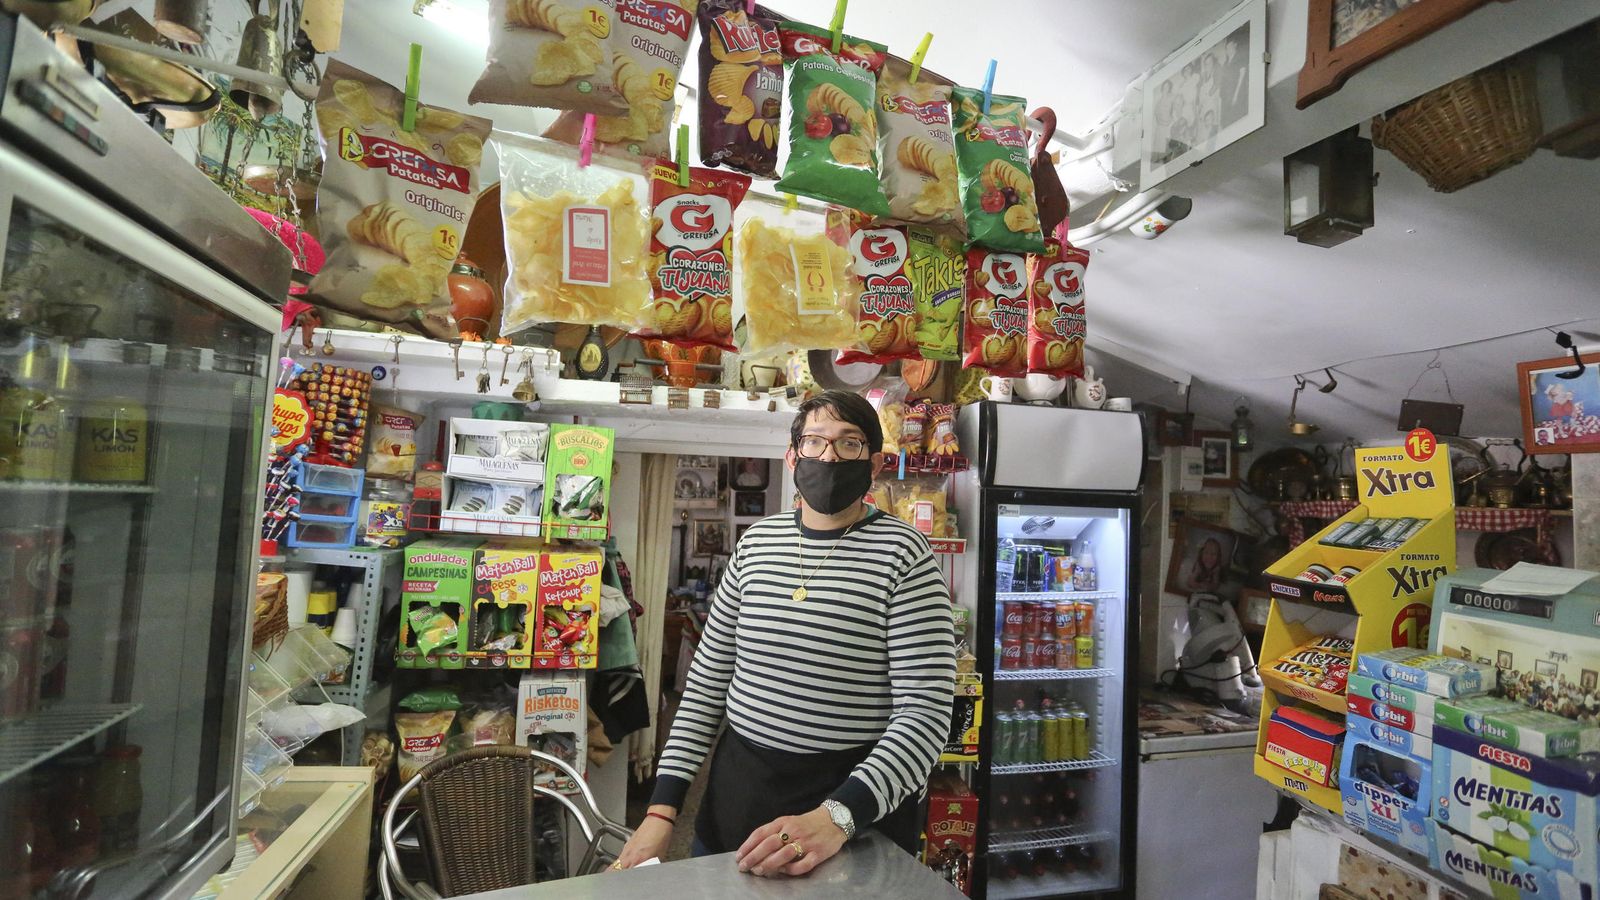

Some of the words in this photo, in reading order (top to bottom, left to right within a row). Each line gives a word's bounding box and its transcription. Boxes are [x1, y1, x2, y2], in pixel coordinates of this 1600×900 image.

[588, 8, 607, 26] 1€
[623, 11, 666, 32] Patatas
[802, 62, 834, 73] Patatas
[658, 72, 675, 89] 1€
[755, 72, 783, 93] Jamó
[391, 164, 441, 187] Patatas
[405, 190, 467, 225] Originales
[670, 205, 715, 233] G
[438, 229, 457, 248] 1€
[682, 229, 720, 240] GREFUSA
[860, 236, 897, 262] G
[672, 257, 724, 272] CORAZONES
[874, 255, 901, 268] GREFUSA
[660, 268, 732, 293] TIJUANA
[870, 284, 909, 293] CORAZONES
[914, 254, 964, 303] Takis
[1053, 270, 1080, 294] G
[92, 427, 139, 443] KAS
[1408, 436, 1431, 457] 1€
[1363, 454, 1403, 462] FORMATO
[1361, 467, 1436, 497] Xtra
[409, 552, 468, 567] onduladas
[1400, 553, 1440, 561] FORMATO
[407, 567, 468, 580] CAMPESINAS
[1387, 565, 1448, 598] Xtra
[1271, 583, 1300, 596] SNICKERS
[1313, 591, 1345, 603] Mars
[1381, 664, 1419, 684] Orbit
[1371, 683, 1408, 703] Orbit
[525, 696, 580, 714] Risketos
[1371, 701, 1408, 724] Orbit
[535, 713, 563, 721] Original
[1464, 712, 1508, 740] Orbit
[1369, 721, 1405, 745] Orbit
[1268, 744, 1286, 755] FIESTA
[1479, 744, 1531, 771] FIESTA
[1354, 780, 1411, 811] dipper
[1371, 801, 1397, 821] XL
[932, 820, 976, 834] POTAJE
